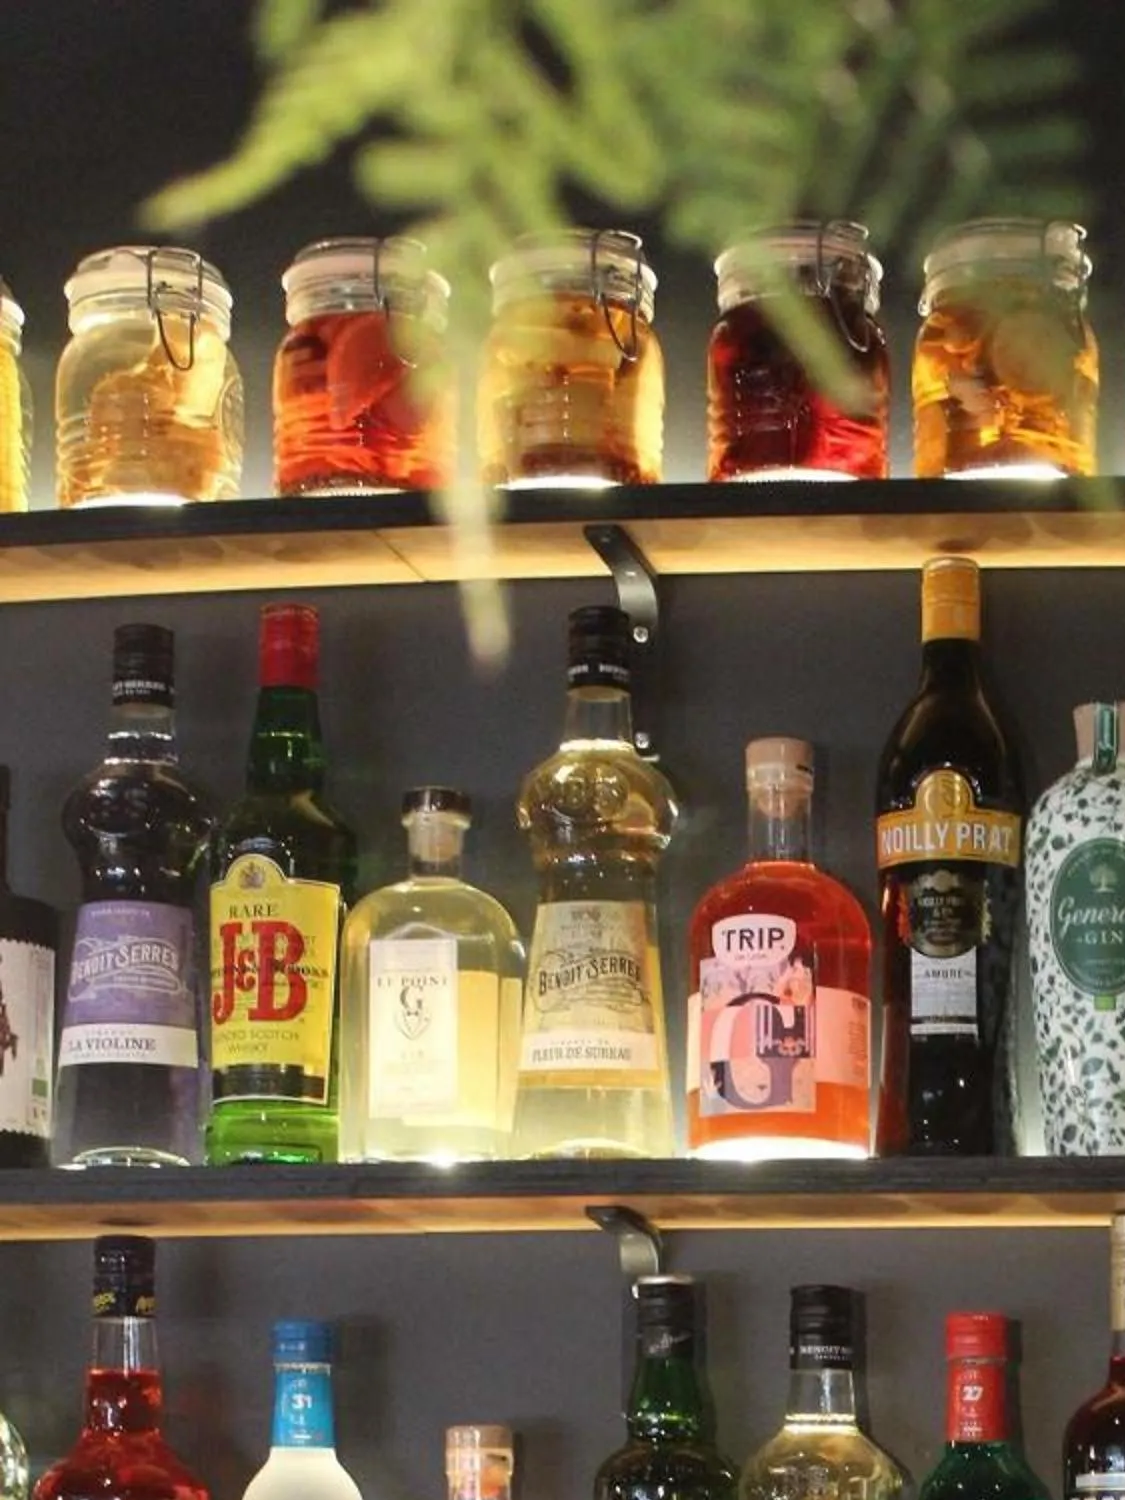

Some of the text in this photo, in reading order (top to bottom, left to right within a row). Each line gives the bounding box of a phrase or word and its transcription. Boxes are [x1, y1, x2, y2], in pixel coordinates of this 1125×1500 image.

[882, 822, 1012, 854] NOILLY PRAT
[229, 903, 279, 918] RARE
[1085, 930, 1123, 944] GIN
[539, 964, 586, 997] BENOIT
[87, 1038, 156, 1050] VIOLINE
